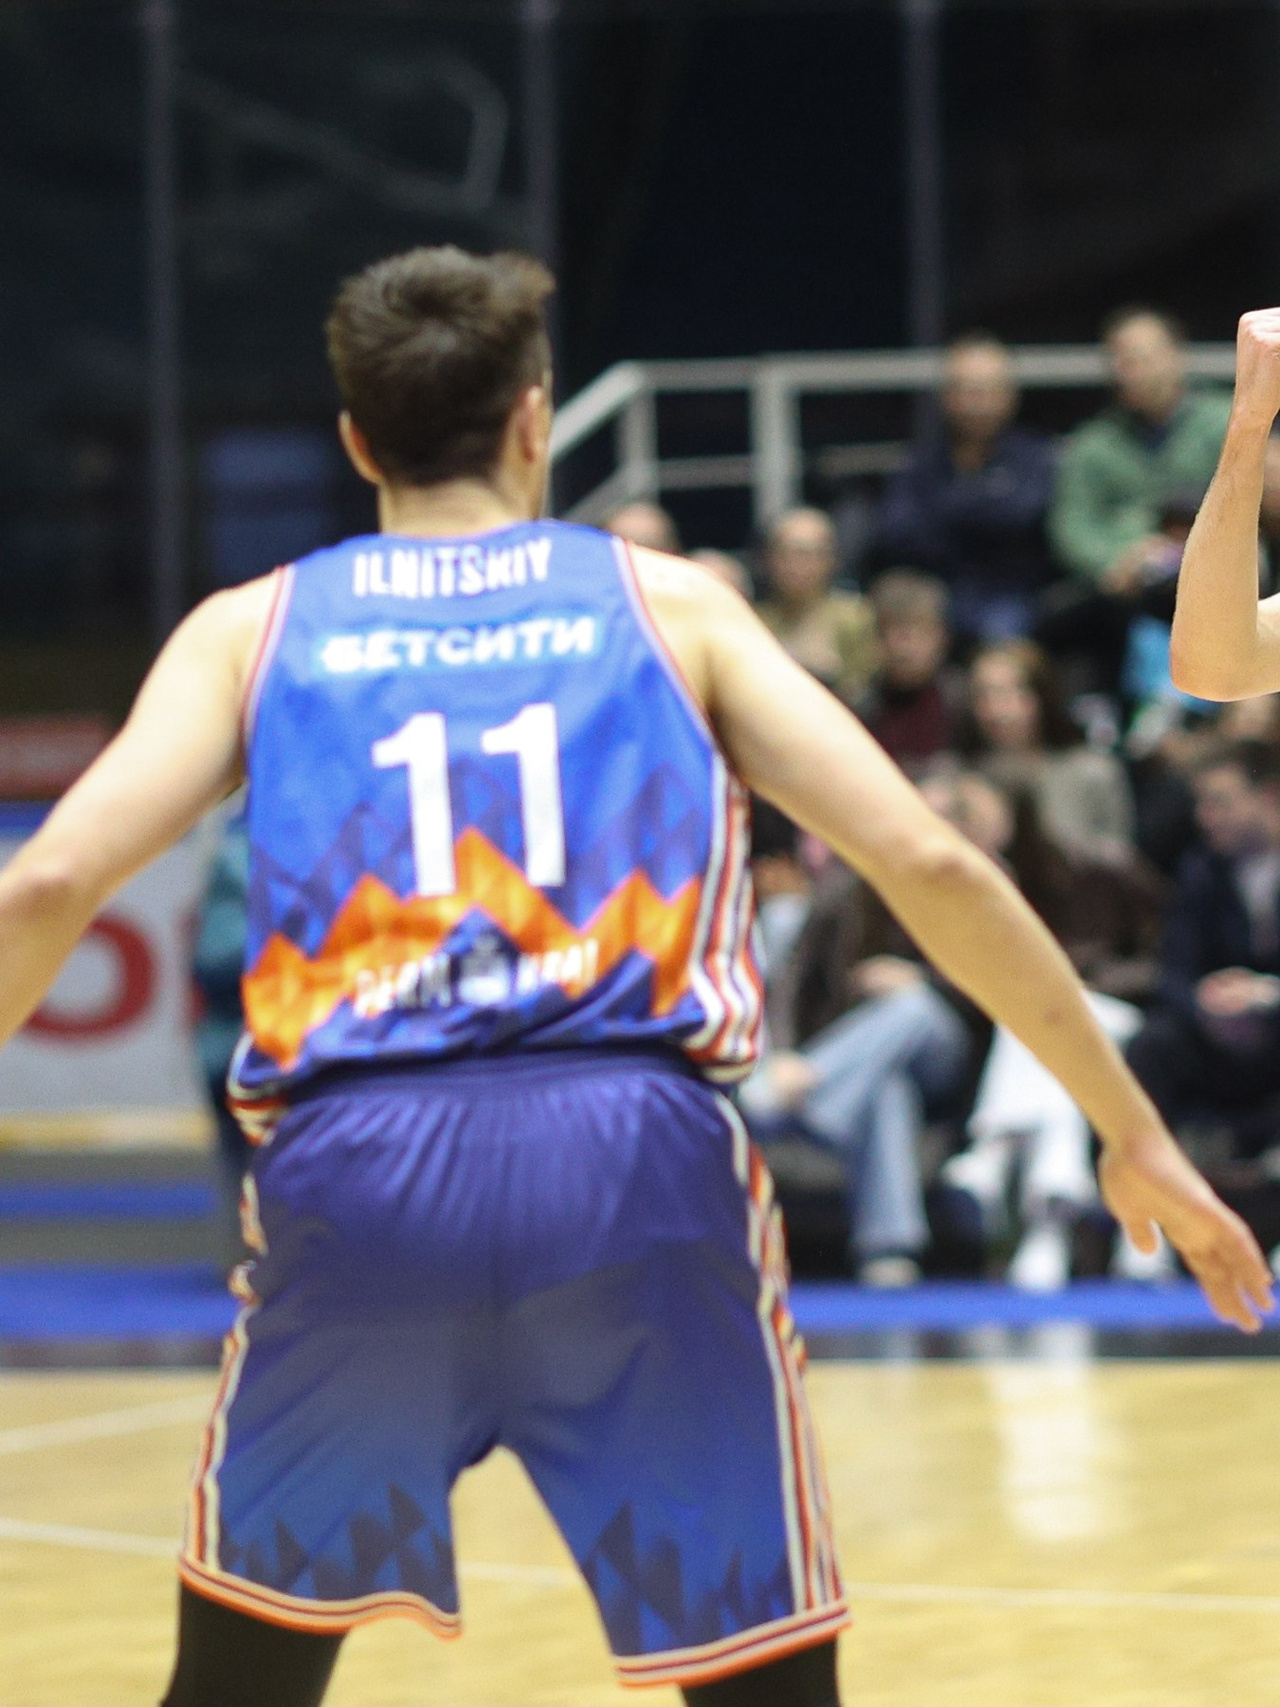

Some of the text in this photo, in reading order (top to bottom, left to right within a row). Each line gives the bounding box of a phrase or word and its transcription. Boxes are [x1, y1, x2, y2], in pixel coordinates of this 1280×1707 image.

[353, 537, 552, 599] ILNITSKIY
[321, 616, 595, 673] БЕТСИТИ
[371, 702, 566, 896] 11
